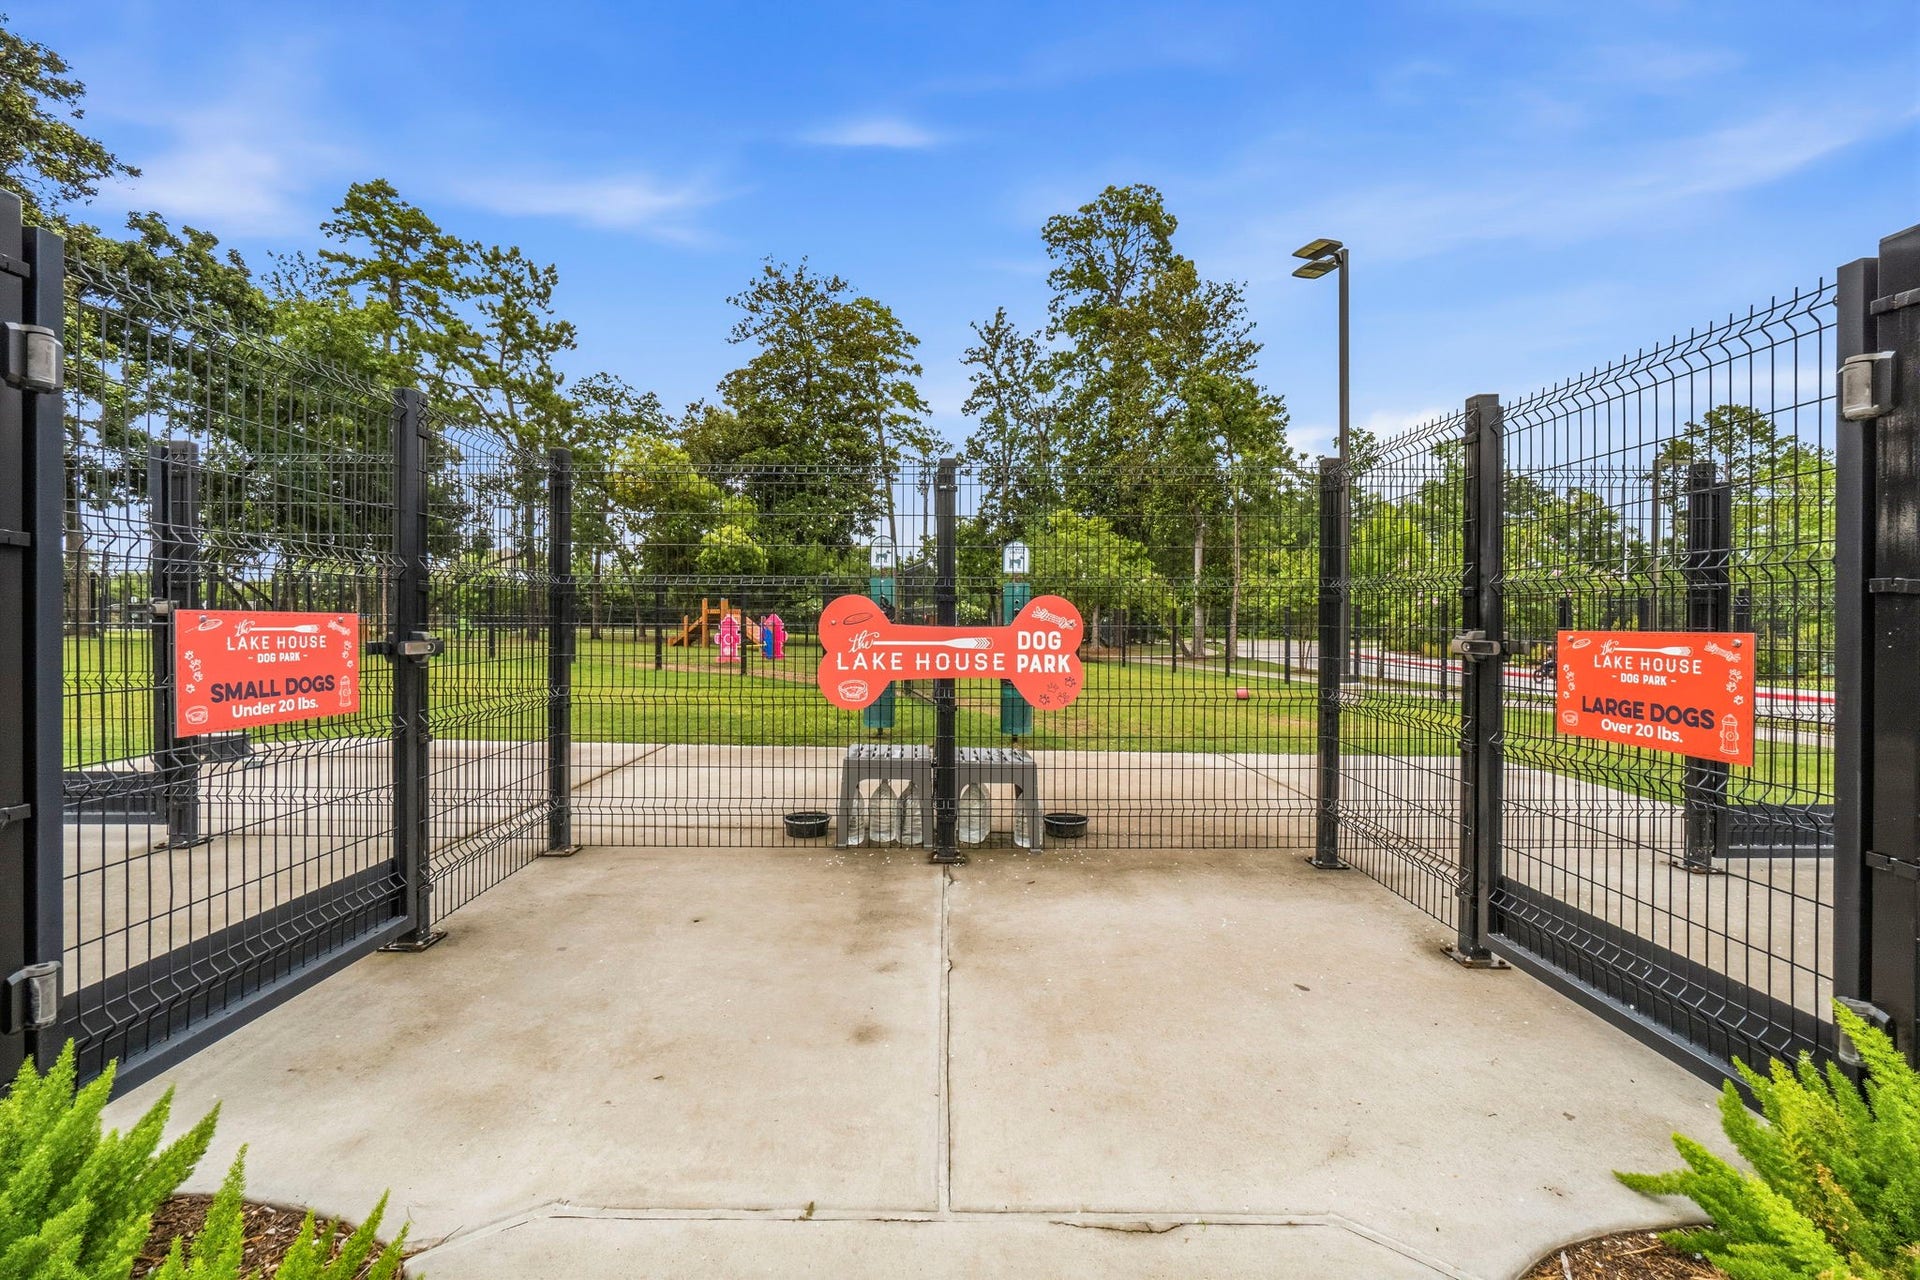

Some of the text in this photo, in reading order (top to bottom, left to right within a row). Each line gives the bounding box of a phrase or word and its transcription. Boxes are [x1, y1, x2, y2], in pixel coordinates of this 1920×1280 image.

[226, 634, 327, 651] LAKE HOUSE
[848, 629, 881, 653] the
[1017, 631, 1062, 650] DOG
[257, 651, 301, 664] DOG PARK
[836, 652, 1006, 671] LAKE HOUSE
[1016, 653, 1071, 673] PARK
[1593, 654, 1703, 675] LAKE HOUSE
[210, 674, 335, 703] SMALL DOGS
[1620, 672, 1667, 686] DOG PARK
[232, 697, 319, 718] Under 20 lbs.
[1582, 695, 1716, 730] LARGE DOGS
[1601, 718, 1684, 743] Over 20 lbs.
